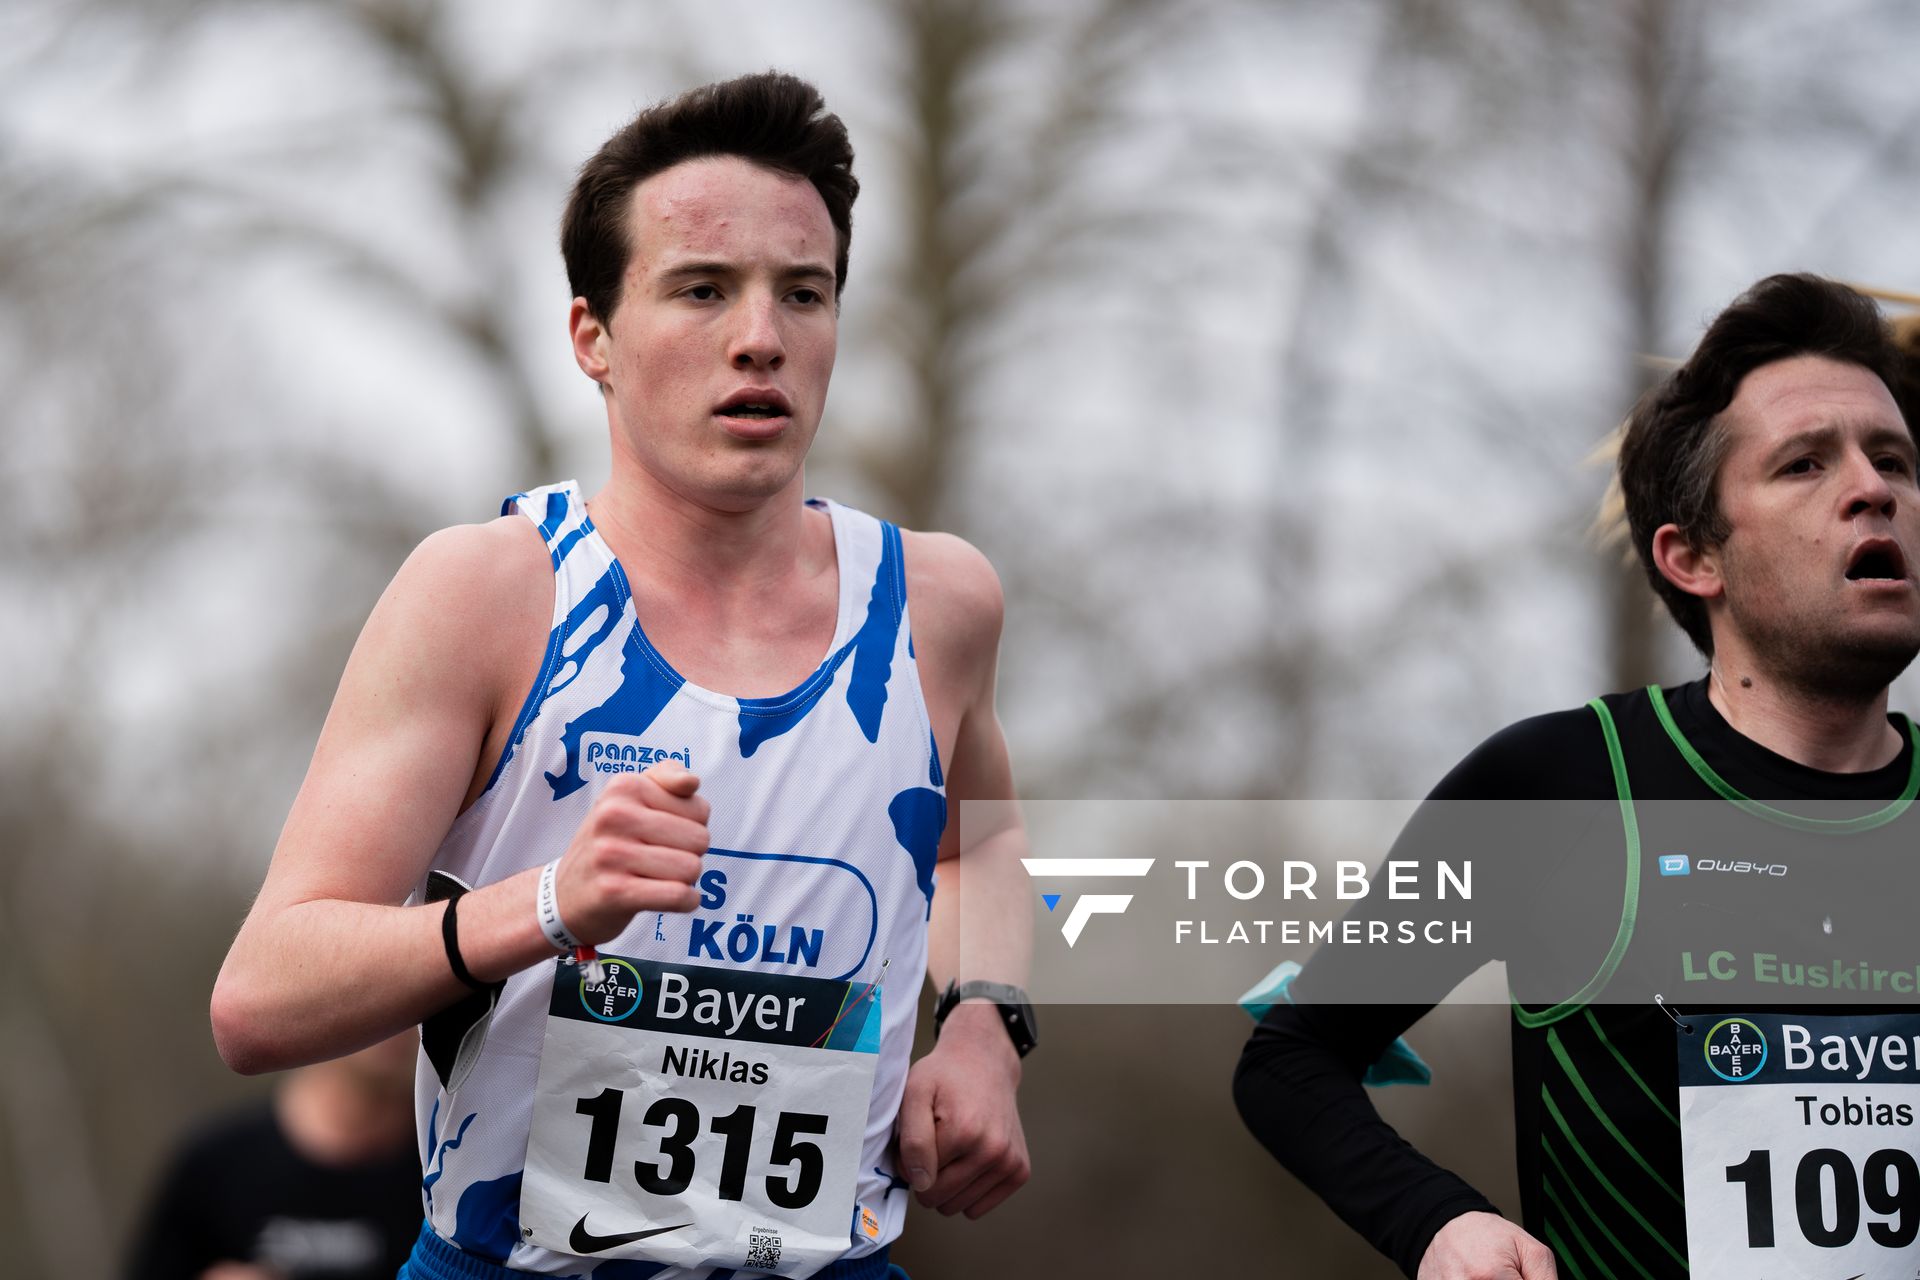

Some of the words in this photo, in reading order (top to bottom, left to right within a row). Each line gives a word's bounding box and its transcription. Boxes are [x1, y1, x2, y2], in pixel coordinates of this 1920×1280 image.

[594, 761, 634, 774] veste
[688, 914, 824, 967] KÖLN
[1682, 950, 1738, 981] LC
[602, 963, 620, 1017] BAYER
[655, 972, 806, 1036] Bayer
[661, 1045, 769, 1085] Niklas
[1710, 1044, 1762, 1056] BAYER
[1730, 1023, 1743, 1077] BAYER
[1795, 1096, 1914, 1126] Tobias
[575, 1087, 829, 1209] 1315
[1726, 1148, 1920, 1248] 109
